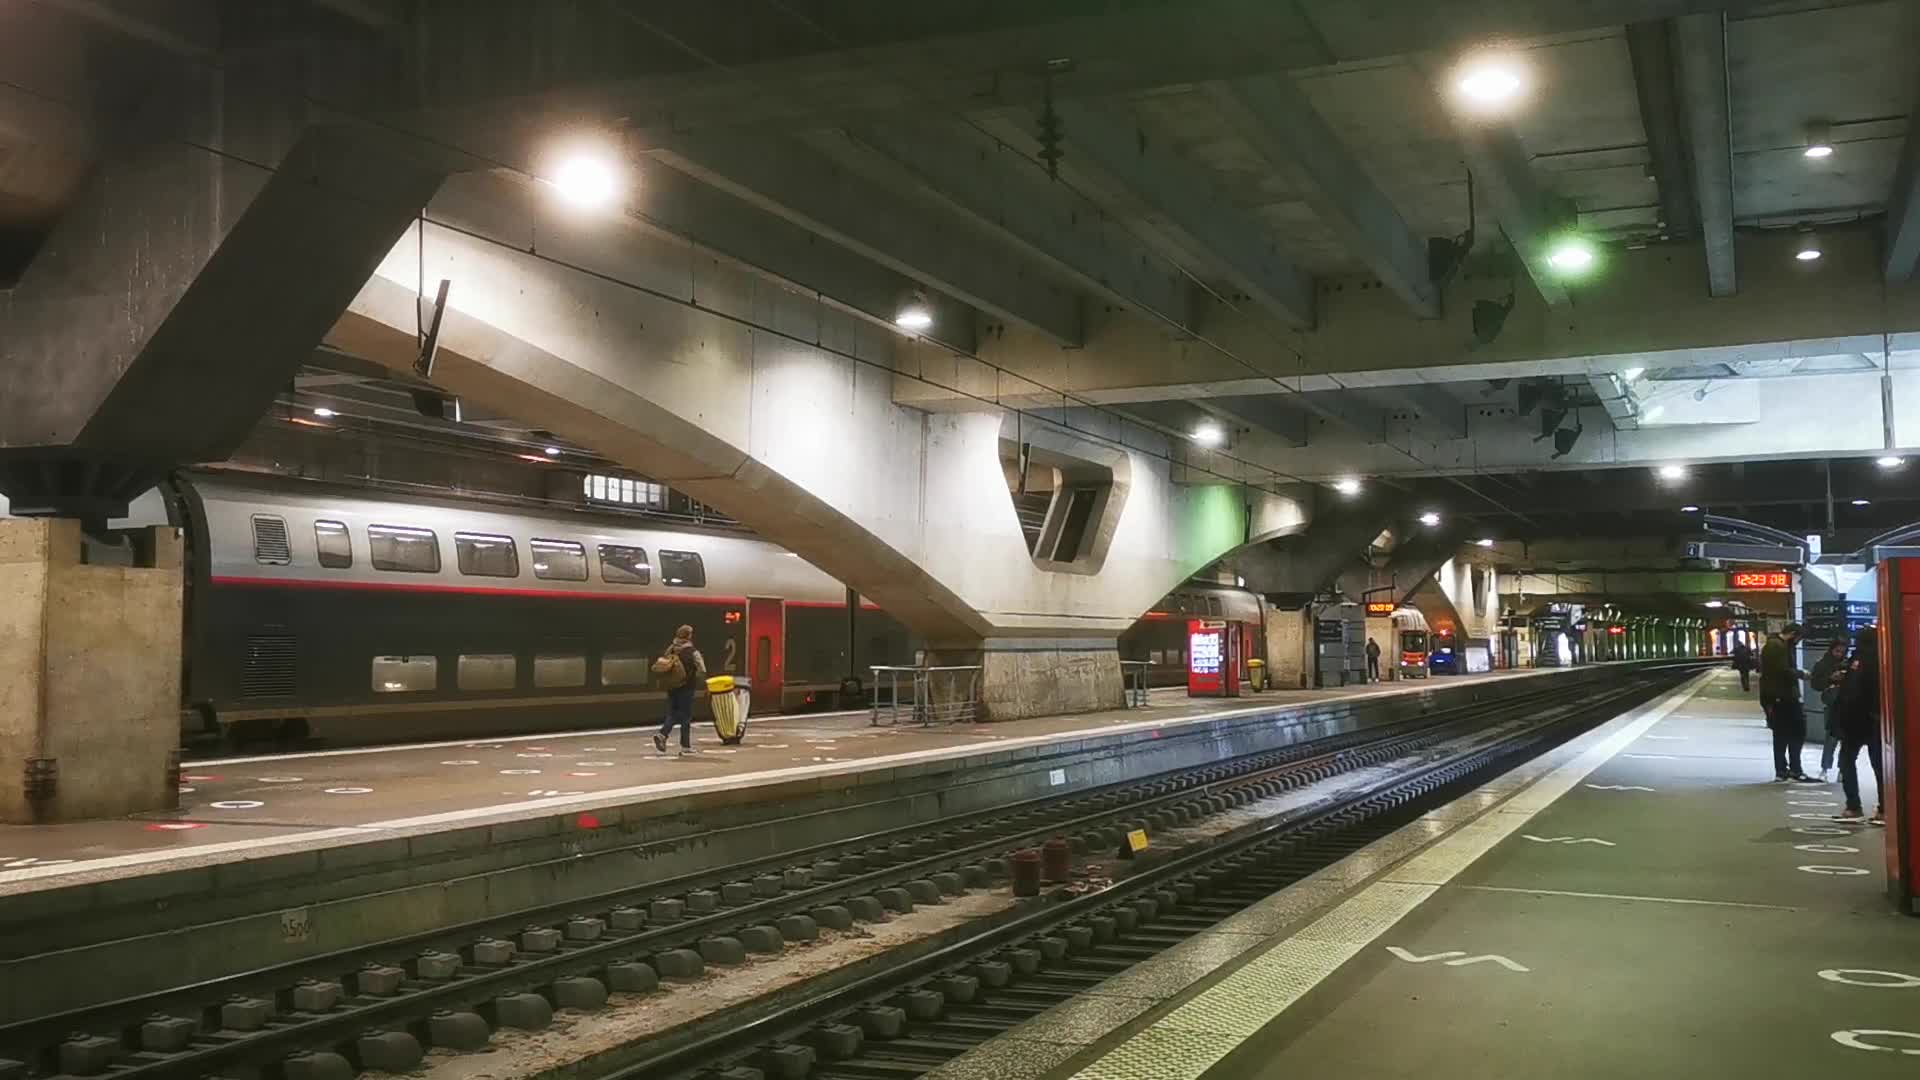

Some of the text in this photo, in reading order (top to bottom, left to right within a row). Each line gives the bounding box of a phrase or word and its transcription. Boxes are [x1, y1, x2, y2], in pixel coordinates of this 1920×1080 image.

[1735, 574, 1786, 586] 12:23 08
[724, 638, 737, 672] 2
